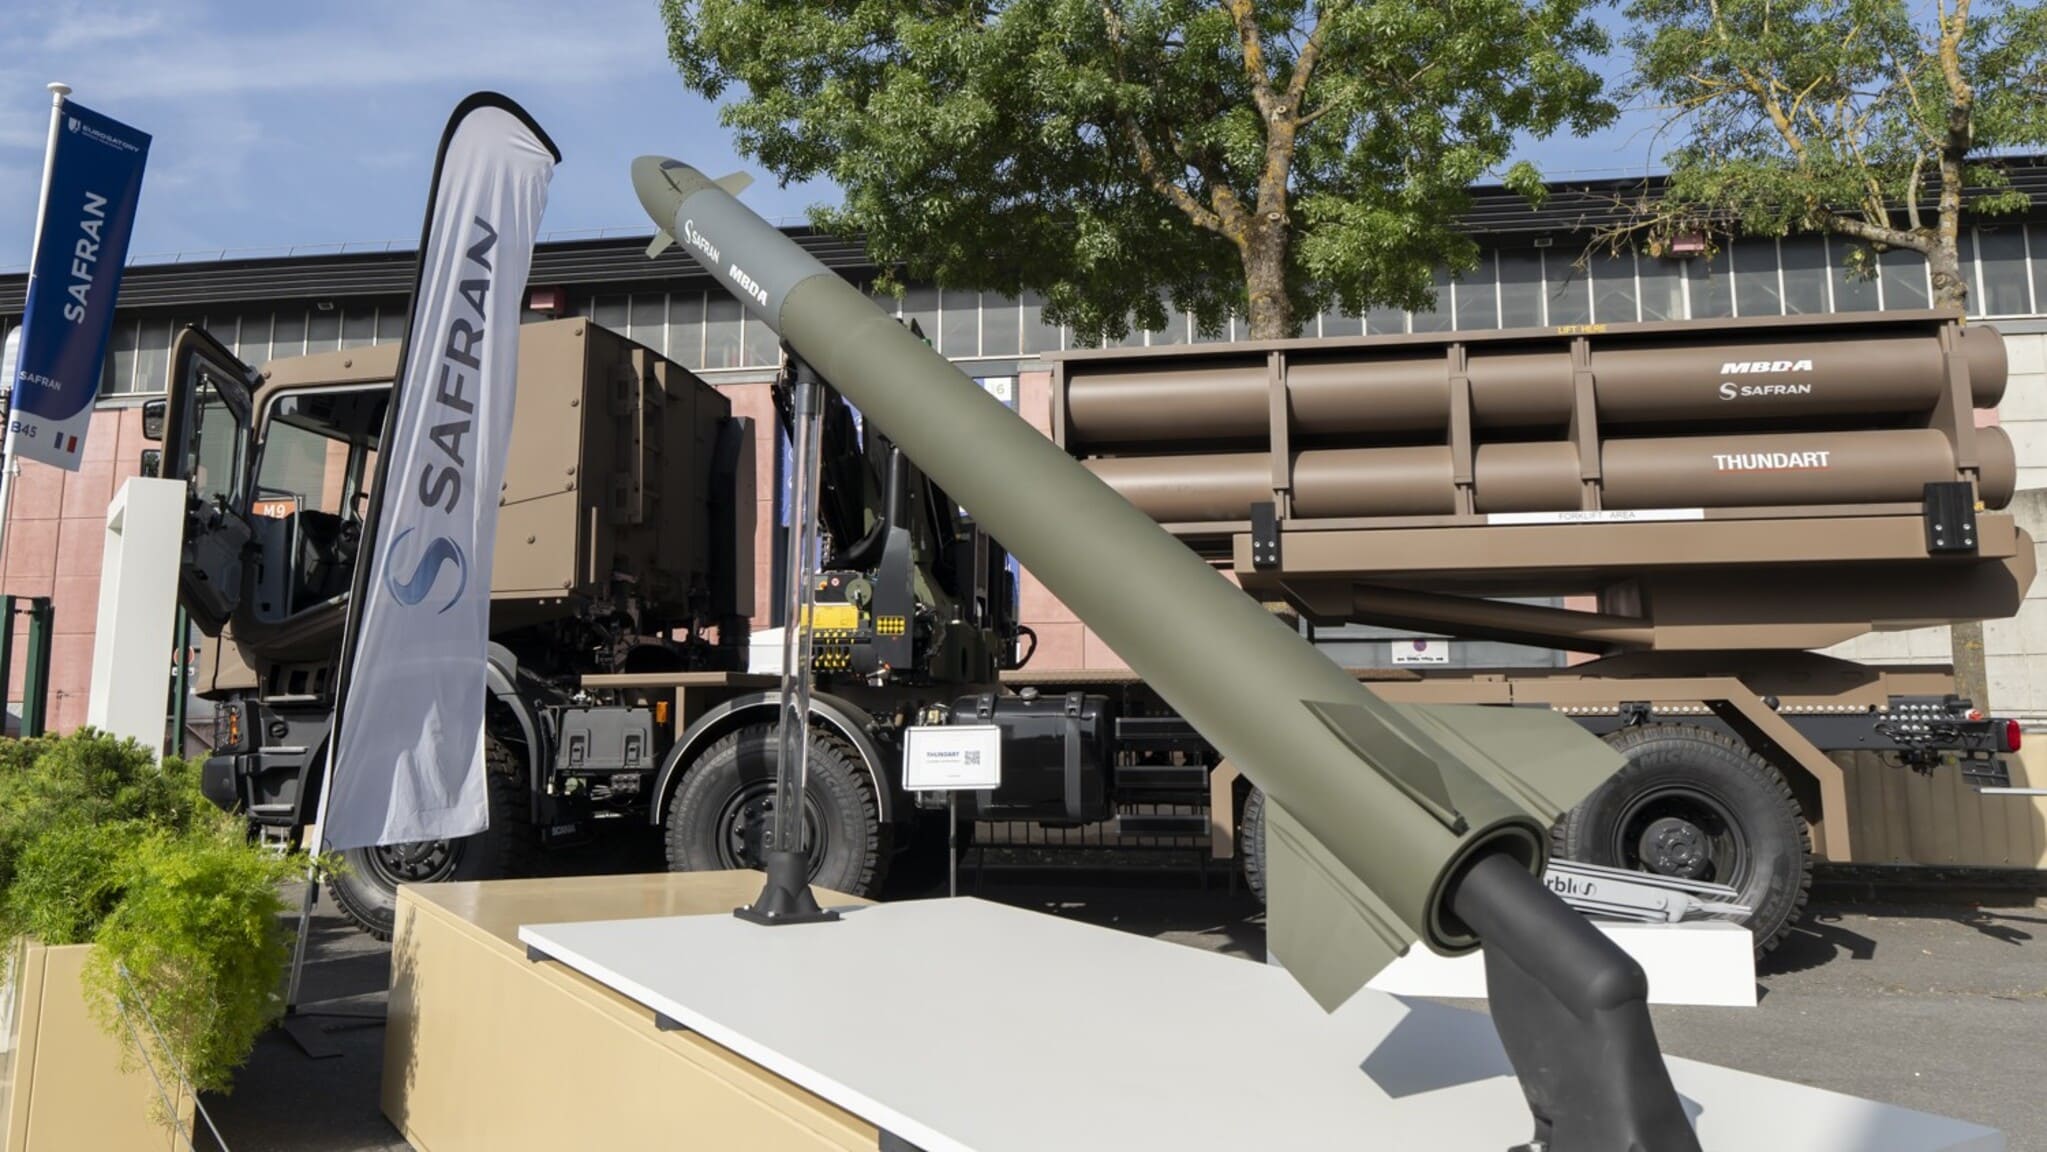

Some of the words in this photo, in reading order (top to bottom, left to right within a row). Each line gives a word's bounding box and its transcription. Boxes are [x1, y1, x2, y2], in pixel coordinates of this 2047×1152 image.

[64, 191, 108, 324] SAFRAN
[691, 230, 720, 264] SAFRAN
[728, 263, 768, 306] MBDA
[1558, 325, 1576, 335] LIFT
[1580, 323, 1607, 335] HERE
[419, 215, 499, 515] SAFRAN
[1720, 359, 1813, 374] MBDA
[19, 370, 62, 391] SAFRAN
[1741, 383, 1812, 397] SAFRAN
[11, 421, 38, 438] B45
[1712, 450, 1831, 470] THUNDART
[263, 503, 286, 519] M9
[1610, 511, 1636, 520] AREA
